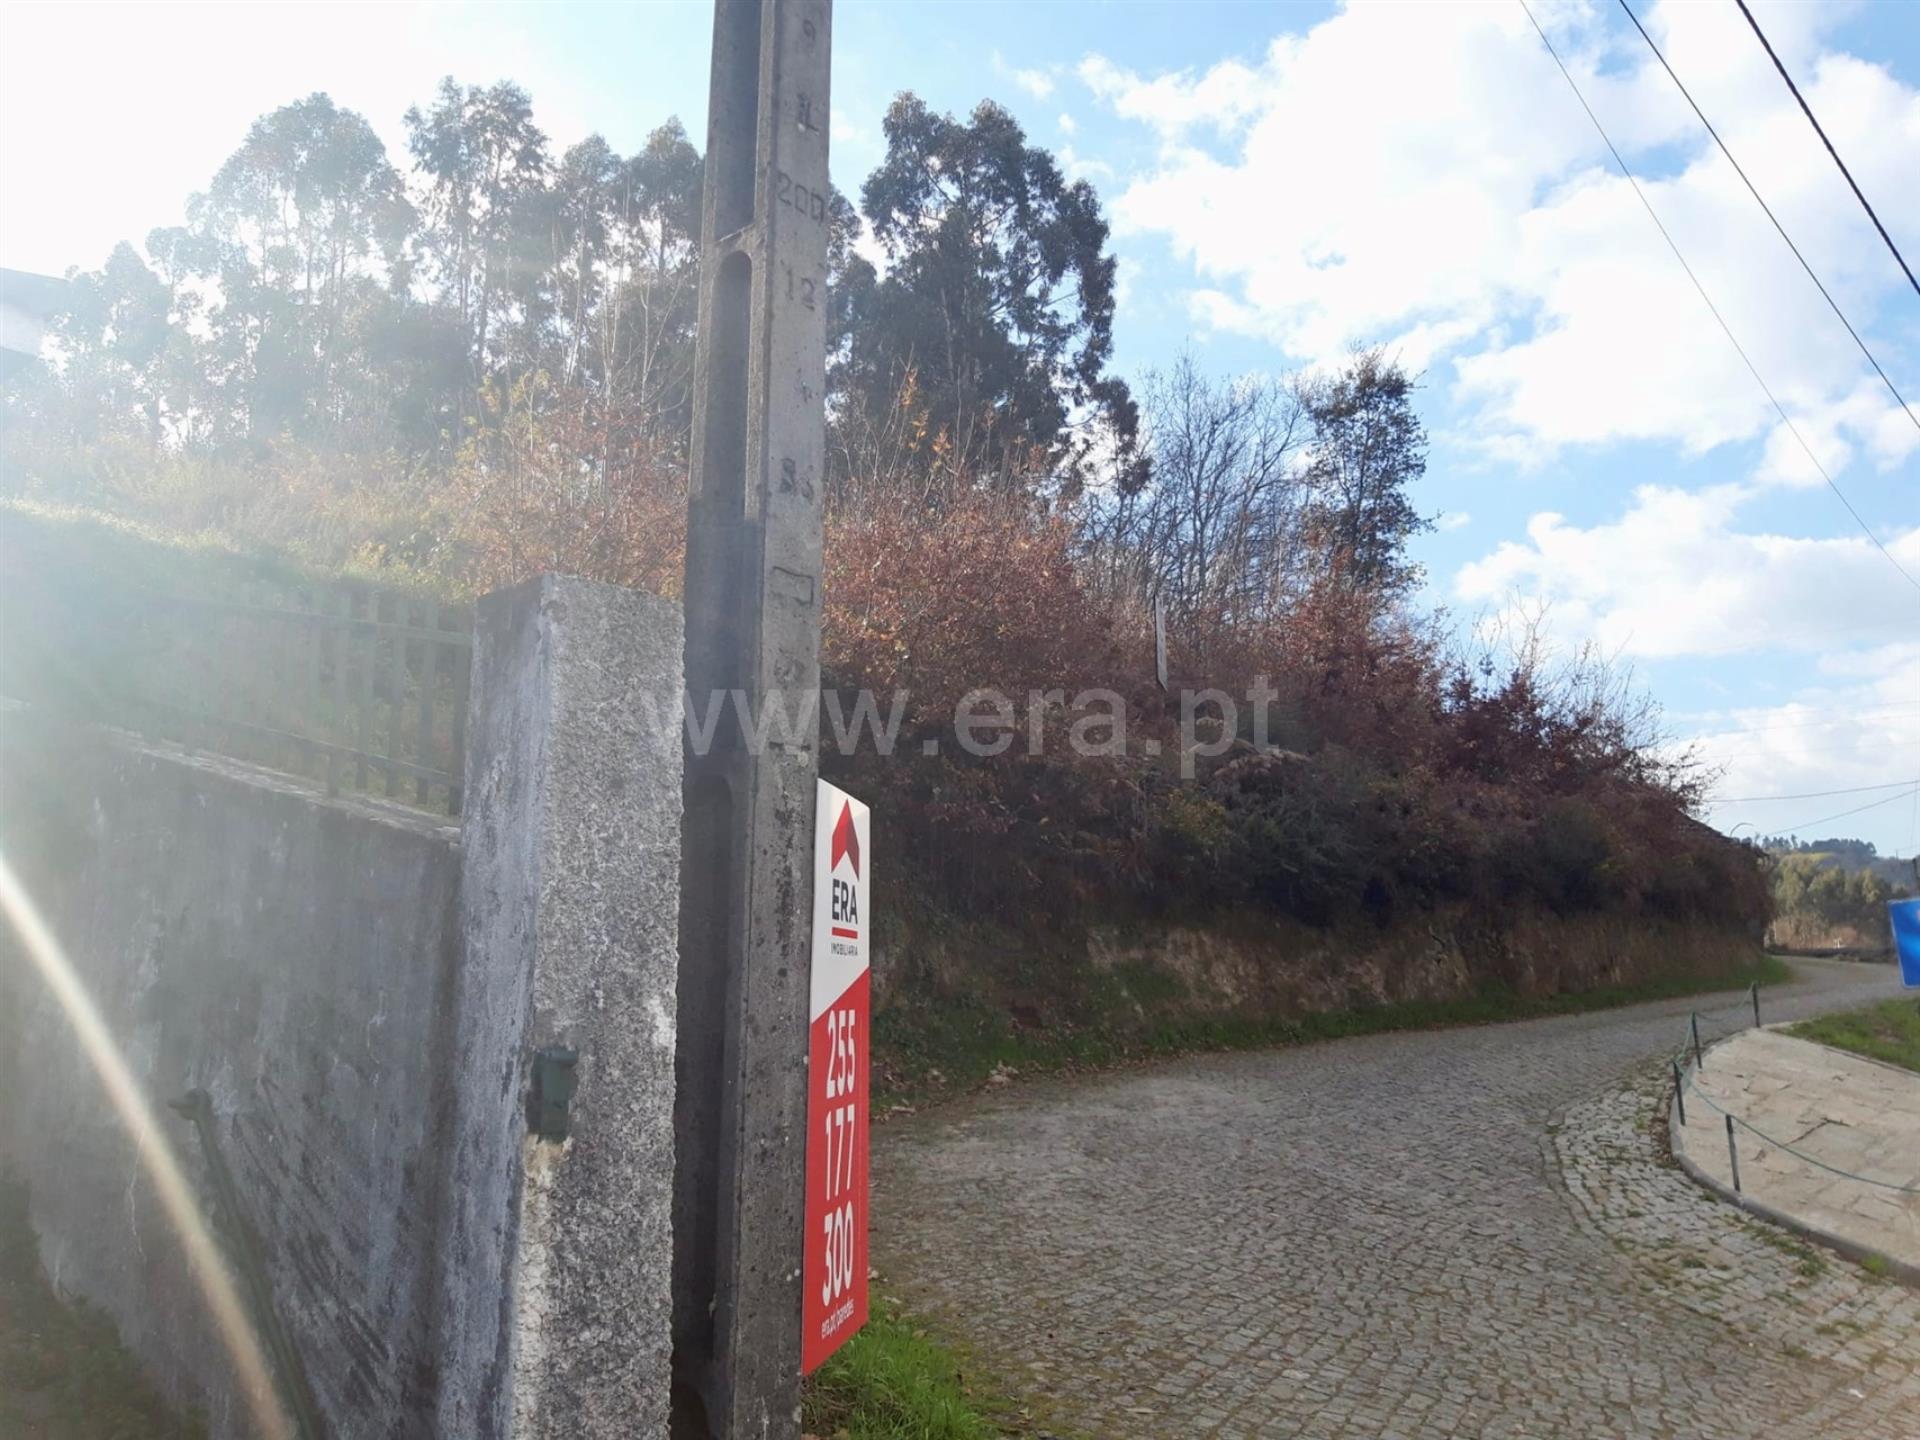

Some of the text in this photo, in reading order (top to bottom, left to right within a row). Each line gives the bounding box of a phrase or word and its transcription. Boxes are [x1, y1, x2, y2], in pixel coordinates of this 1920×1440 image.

[832, 879, 858, 925] ERA
[826, 1009, 855, 1099] 255
[826, 1104, 855, 1200] 177
[822, 1201, 853, 1306] 300
